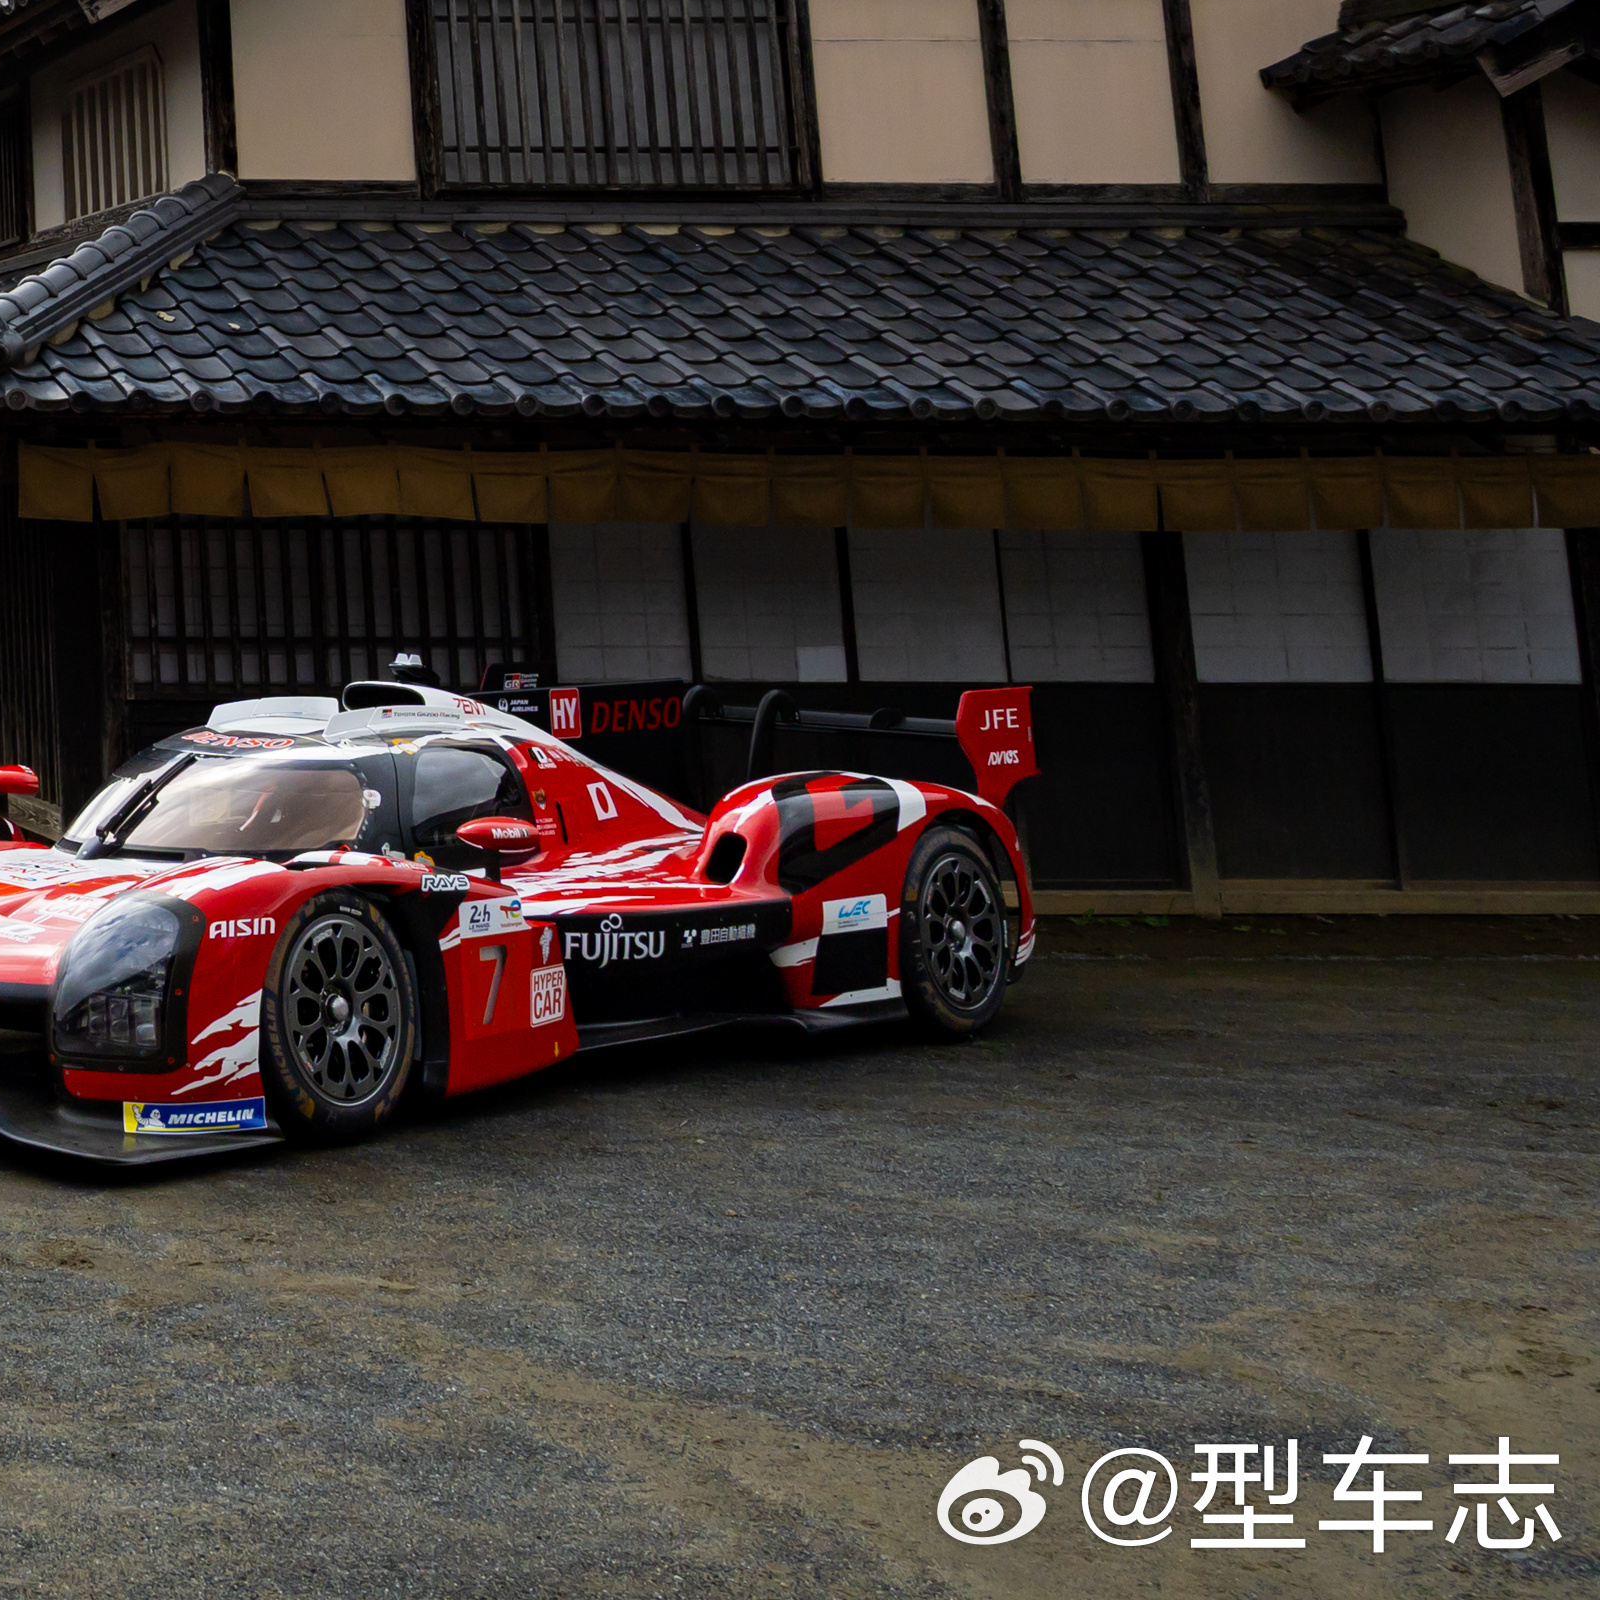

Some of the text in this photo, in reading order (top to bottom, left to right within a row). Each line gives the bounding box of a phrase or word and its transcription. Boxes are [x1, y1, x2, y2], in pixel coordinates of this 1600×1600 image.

[552, 697, 577, 730] HY
[591, 696, 682, 735] DENSO
[980, 708, 1019, 731] JFE
[181, 730, 295, 749] DENSO
[491, 827, 520, 839] Mobil
[421, 874, 471, 892] RAYS
[838, 900, 871, 919] WEC
[209, 917, 275, 939] AISIN
[564, 930, 665, 968] FUJITSU
[479, 944, 507, 1025] 7
[533, 969, 563, 992] HYPER
[533, 988, 562, 1020] CAR
[168, 1108, 255, 1125] MICHELIN
